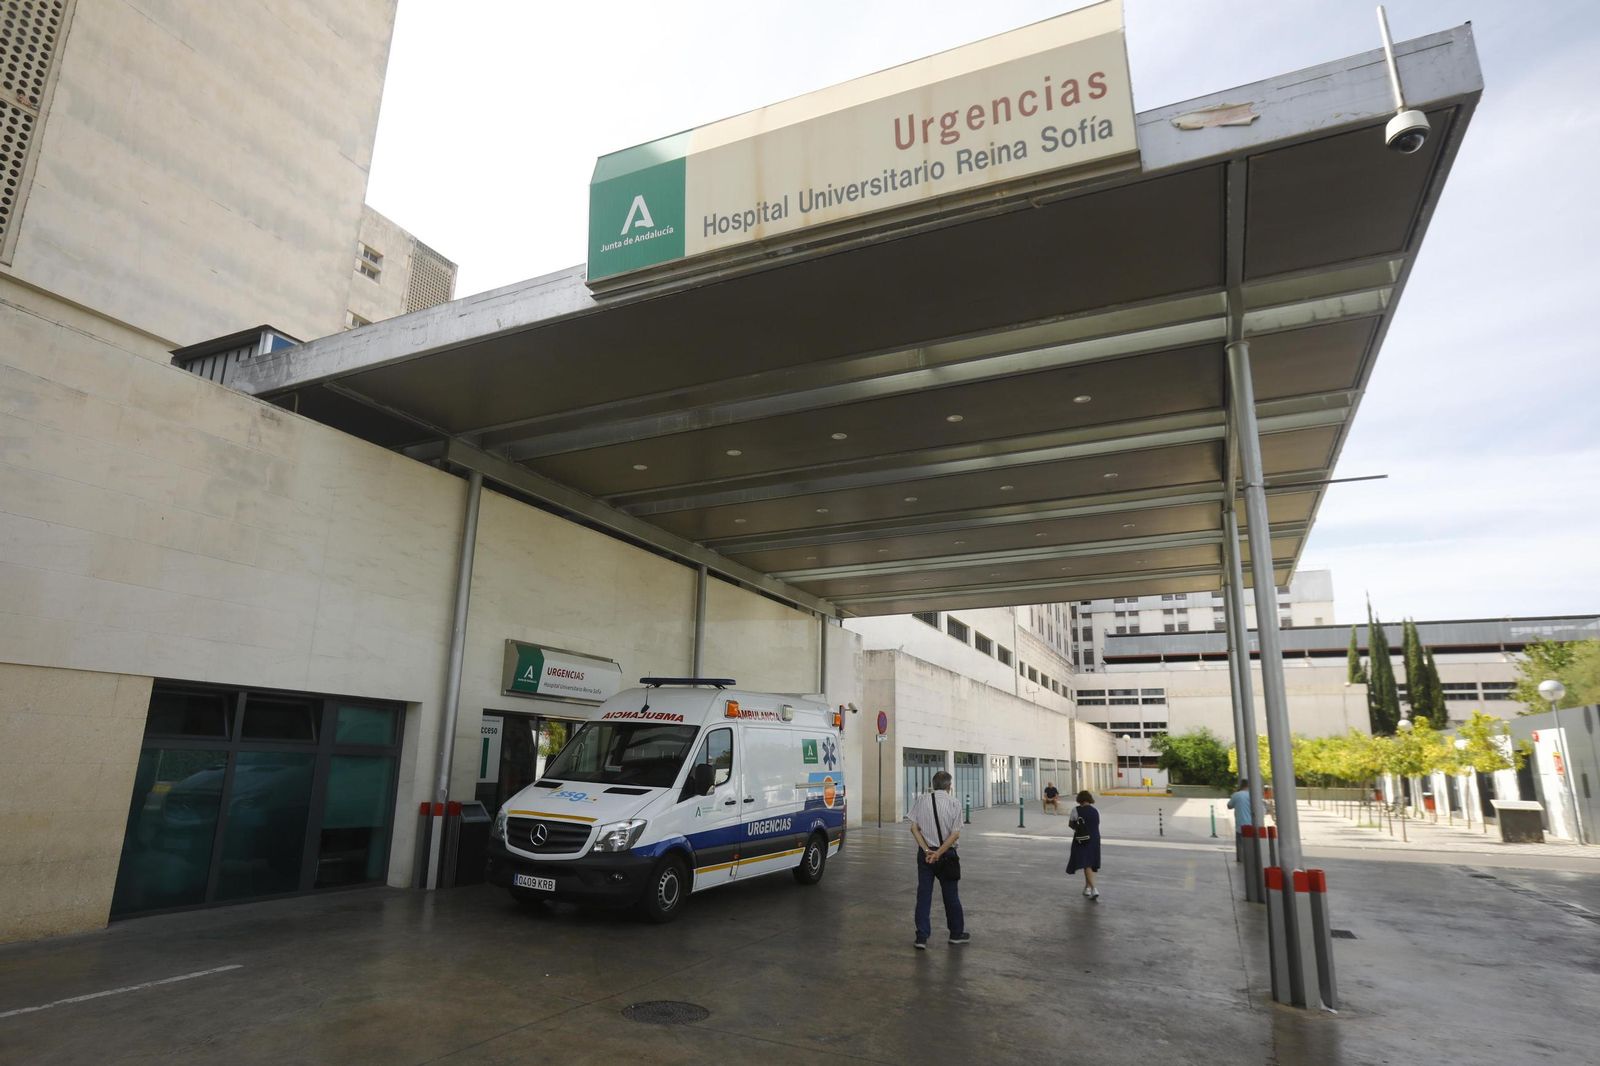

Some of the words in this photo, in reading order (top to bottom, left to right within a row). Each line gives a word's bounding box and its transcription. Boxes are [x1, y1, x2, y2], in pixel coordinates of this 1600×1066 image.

[894, 71, 1108, 151] Urgencias
[703, 194, 789, 238] Hospital
[798, 159, 945, 214] Universitario
[956, 140, 1028, 175] Reina
[1040, 115, 1114, 153] Sofía
[600, 240, 623, 253] Junta
[623, 236, 634, 247] de
[634, 225, 674, 243] Andalucía
[547, 667, 585, 681] URGENCIAS
[747, 818, 792, 836] URGENCIAS
[519, 876, 537, 888] 0409
[537, 879, 554, 890] KRB
